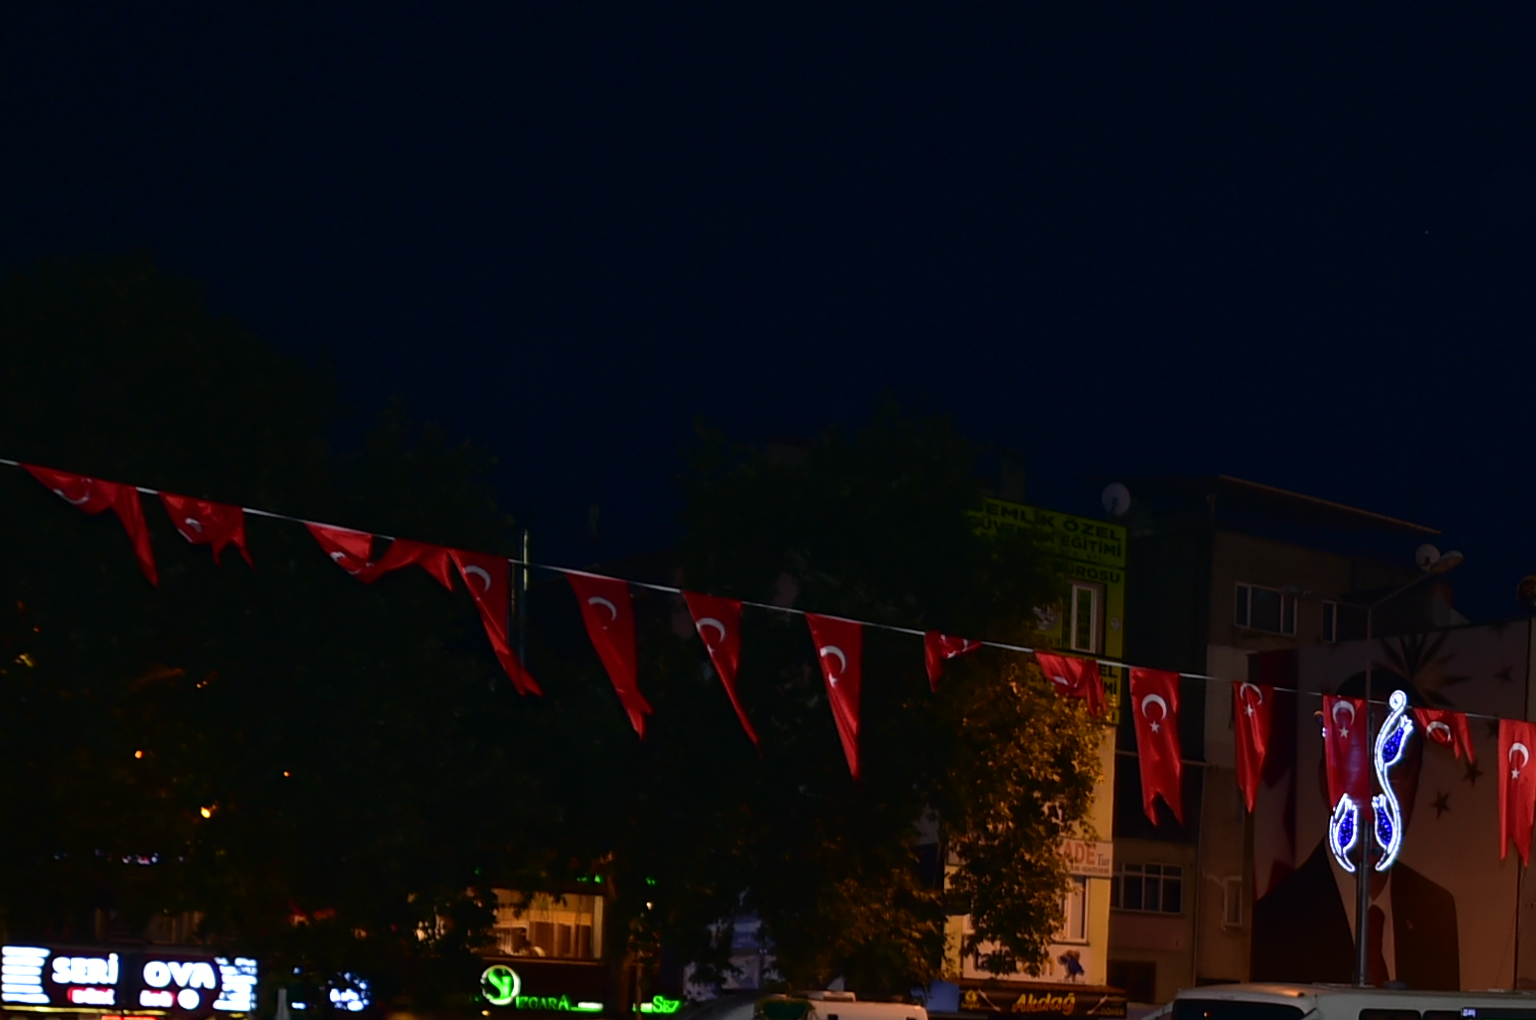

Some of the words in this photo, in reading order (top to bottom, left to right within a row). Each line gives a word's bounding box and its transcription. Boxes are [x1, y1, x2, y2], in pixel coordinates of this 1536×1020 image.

[1063, 517, 1121, 541] ÖZEL
[1061, 535, 1121, 557] EĞİTİMİ
[1011, 993, 1077, 1015] Akdağ
